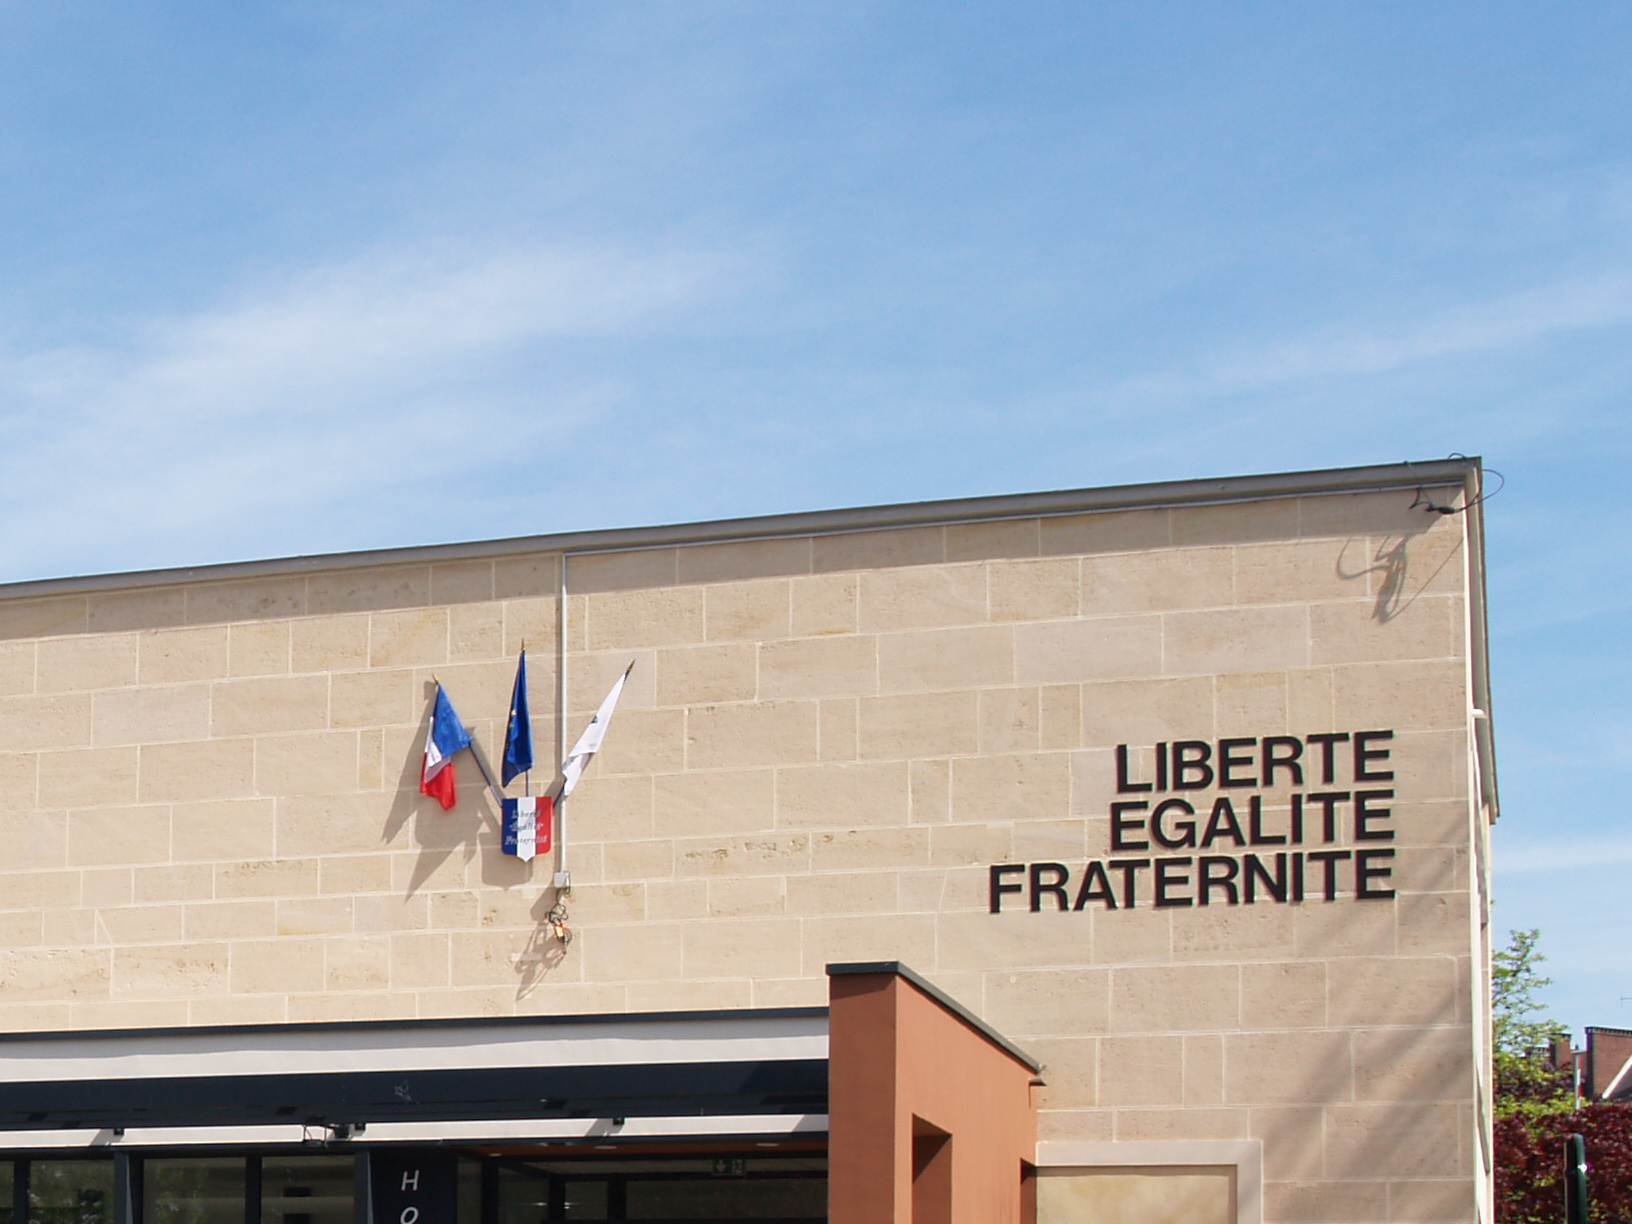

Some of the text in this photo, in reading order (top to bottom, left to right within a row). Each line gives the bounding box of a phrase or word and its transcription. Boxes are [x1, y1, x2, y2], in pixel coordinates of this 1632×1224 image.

[1115, 729, 1394, 794] LIBERTE
[1110, 789, 1395, 851] EGALITE
[989, 848, 1396, 914] FRATERNITE
